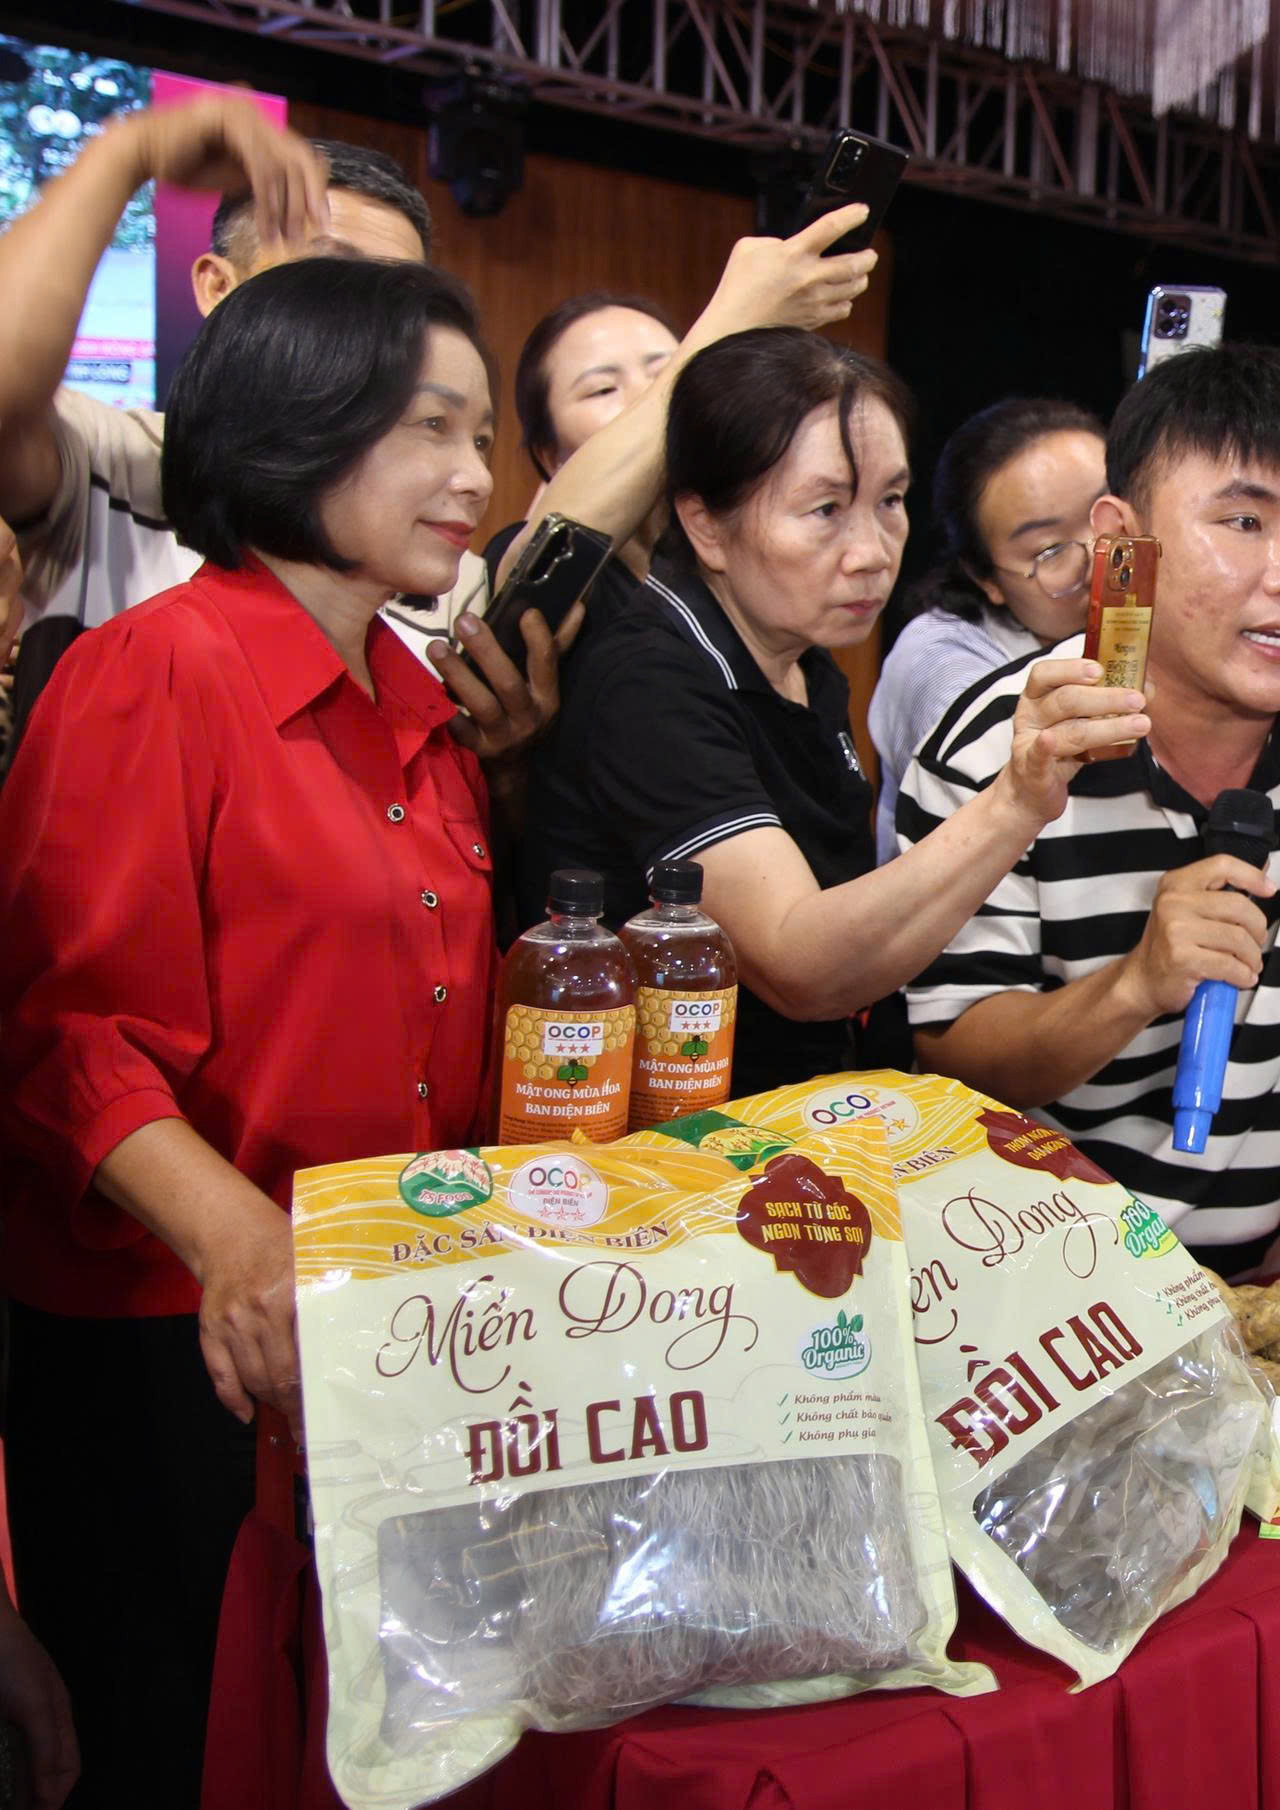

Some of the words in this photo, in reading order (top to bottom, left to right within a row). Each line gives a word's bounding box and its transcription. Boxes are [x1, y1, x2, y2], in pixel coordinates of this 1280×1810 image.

[675, 1003, 720, 1015] OCOP
[548, 1025, 601, 1038] OCOP
[639, 1058, 667, 1074] MẬT
[668, 1063, 692, 1073] ONG
[694, 1060, 716, 1073] MÙA
[516, 1082, 542, 1099] MẬT
[543, 1087, 570, 1099] ONG
[573, 1085, 600, 1098] MÙA
[601, 1080, 621, 1096] HOA
[648, 1077, 672, 1089] BAN
[675, 1077, 703, 1093] ĐIỆN
[703, 1075, 722, 1089] BIÊN
[525, 1103, 550, 1115] BAN
[553, 1103, 583, 1120] ĐIỆN
[584, 1101, 610, 1115] BIÊN
[811, 1088, 880, 1124] OCOP
[907, 1146, 957, 1172] BIÊN
[528, 1167, 592, 1190] OCOP
[765, 1201, 802, 1219] SẠCH
[803, 1201, 823, 1220] TỪ
[827, 1201, 851, 1220] GỐC
[393, 1234, 452, 1263] ĐẶC
[605, 1220, 670, 1249] BIÊN
[761, 1223, 801, 1244] NGON
[803, 1223, 841, 1244] TỪNG
[845, 1226, 864, 1245] SỢI
[941, 1186, 1120, 1279] Dong
[1161, 1282, 1184, 1298] Không
[558, 1260, 759, 1371] Dong
[1183, 1305, 1209, 1320] Không
[812, 1326, 854, 1351] 100%
[802, 1341, 865, 1371] Organic
[935, 1344, 1062, 1469] ĐỒI
[1038, 1301, 1144, 1392] CAO
[794, 1393, 830, 1404] Không
[796, 1411, 832, 1423] Không
[835, 1407, 858, 1420] chất
[465, 1381, 564, 1487] ĐỒI
[585, 1389, 709, 1464] CAO
[799, 1429, 835, 1442] Không
[838, 1429, 859, 1440] phụ
[861, 1427, 876, 1438] gia
